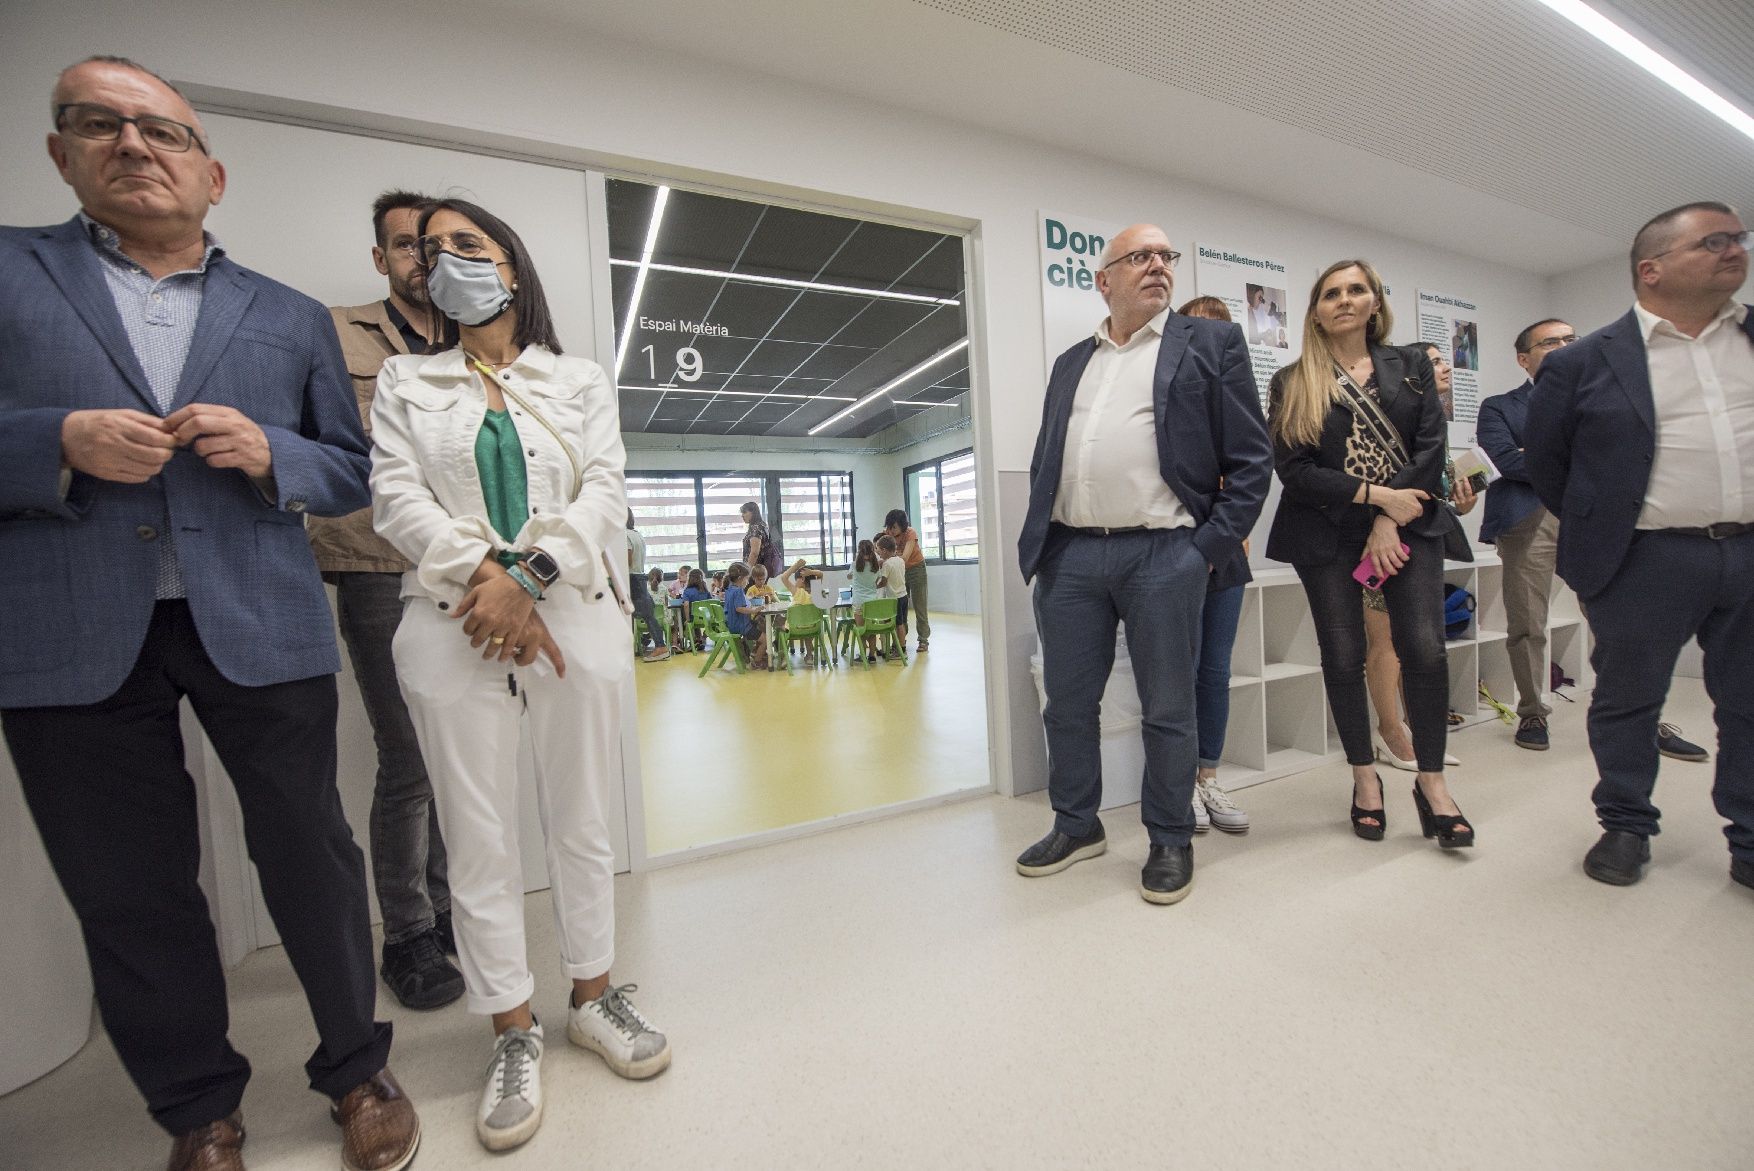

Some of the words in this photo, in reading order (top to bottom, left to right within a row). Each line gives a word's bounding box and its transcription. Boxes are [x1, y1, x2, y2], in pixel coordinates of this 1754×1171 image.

[1199, 247, 1222, 260] Belén
[1223, 252, 1264, 268] Ballesteros
[1265, 260, 1285, 272] Pérez
[1047, 256, 1099, 291] ciè
[639, 316, 677, 333] Espai
[679, 319, 729, 336] Matèria
